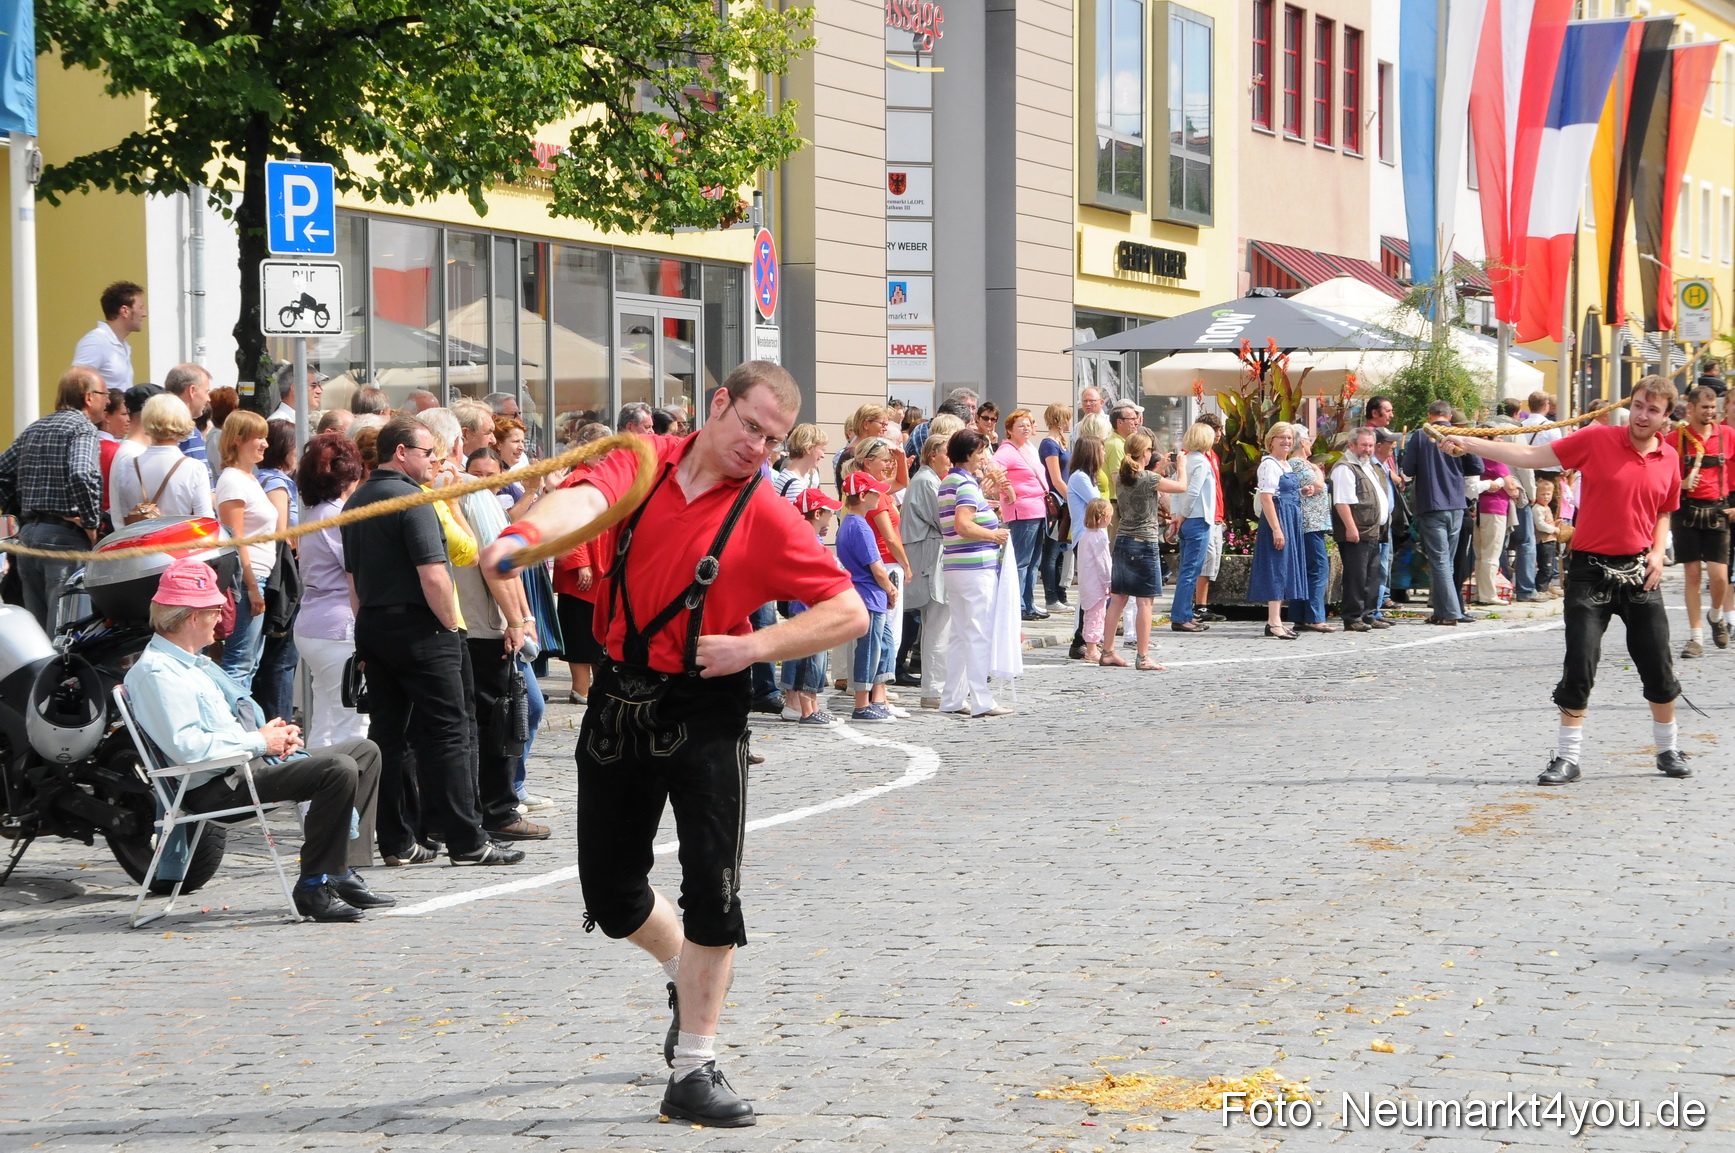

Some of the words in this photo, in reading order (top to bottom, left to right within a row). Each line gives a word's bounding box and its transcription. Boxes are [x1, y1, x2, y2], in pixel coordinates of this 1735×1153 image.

[283, 174, 319, 242] P
[897, 242, 928, 251] WEBER
[1689, 288, 1701, 304] H
[890, 344, 928, 356] HAARE
